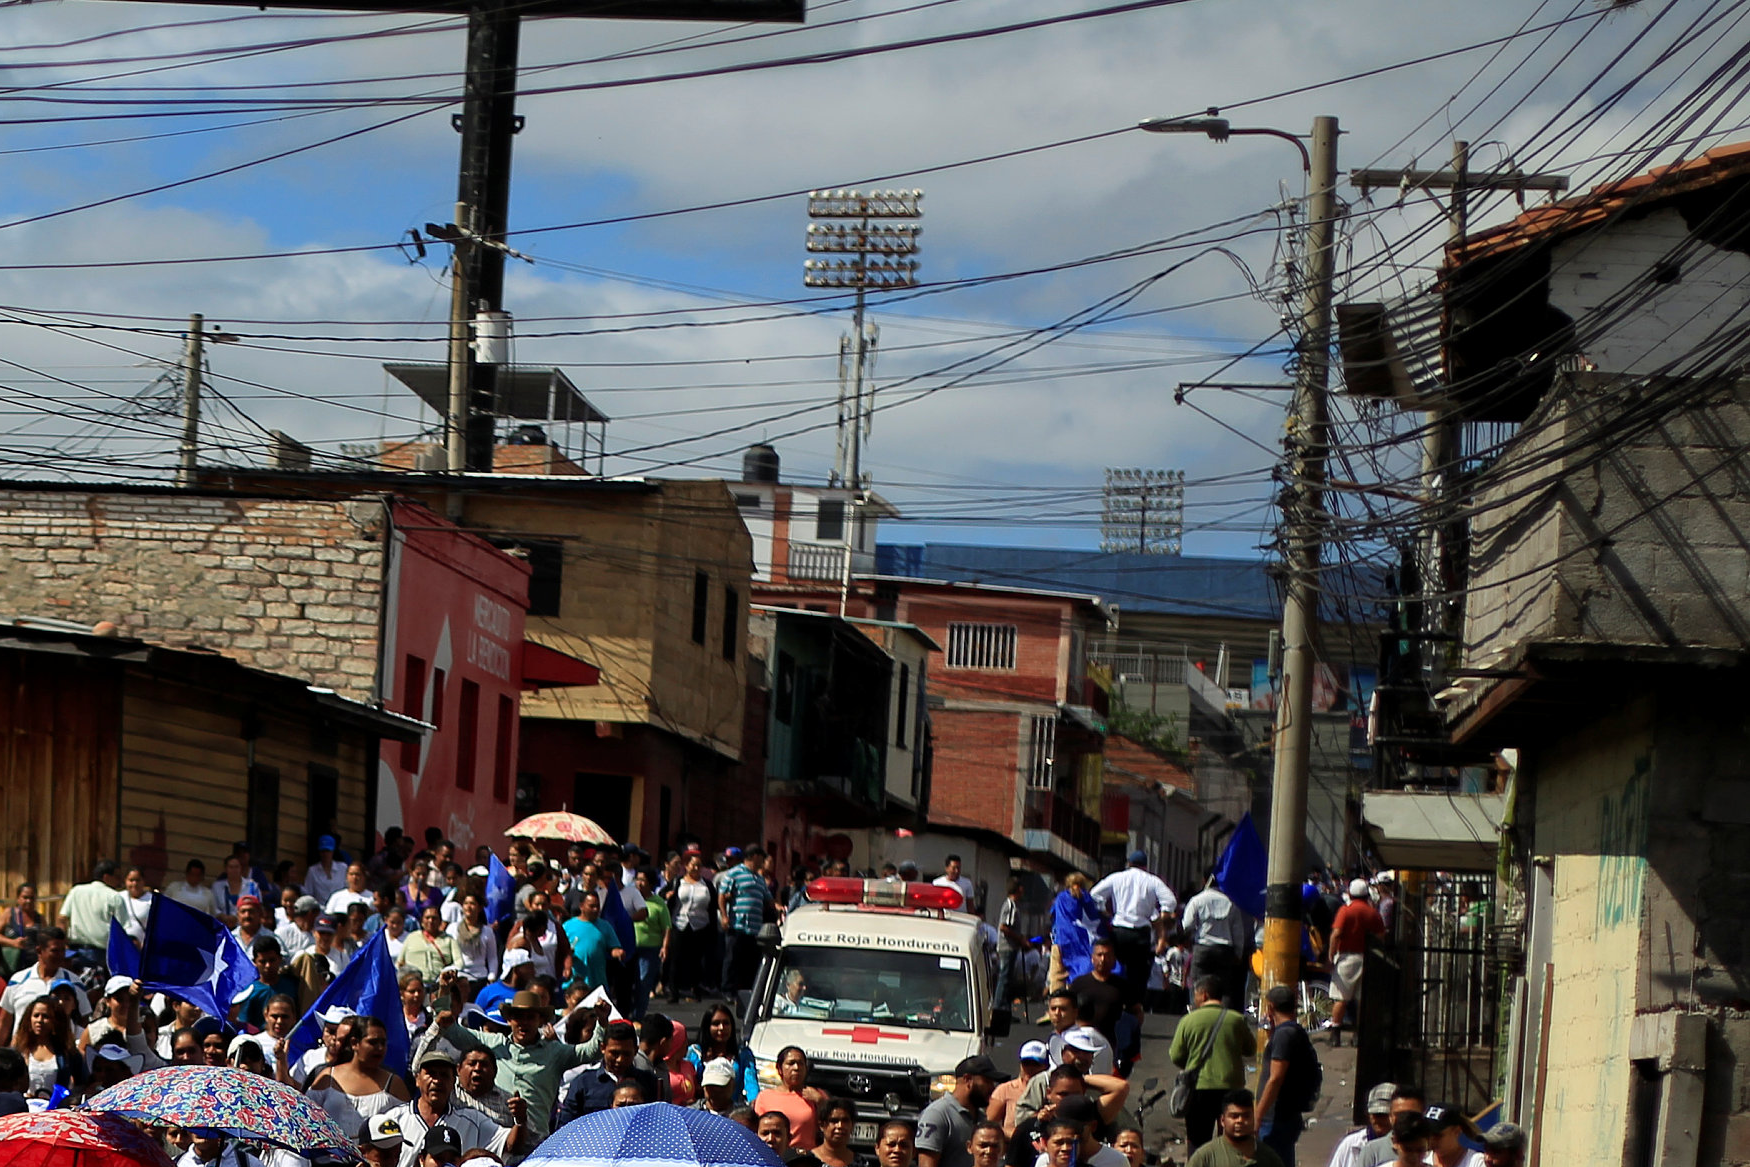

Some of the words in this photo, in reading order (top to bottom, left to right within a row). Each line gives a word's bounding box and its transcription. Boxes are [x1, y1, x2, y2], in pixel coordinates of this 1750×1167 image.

[797, 932, 831, 943] Cruz
[836, 933, 870, 947] Roja
[876, 935, 960, 954] Hondureña
[805, 1048, 829, 1059] Cruz
[832, 1050, 856, 1062] Roja
[859, 1052, 918, 1065] Hondureña
